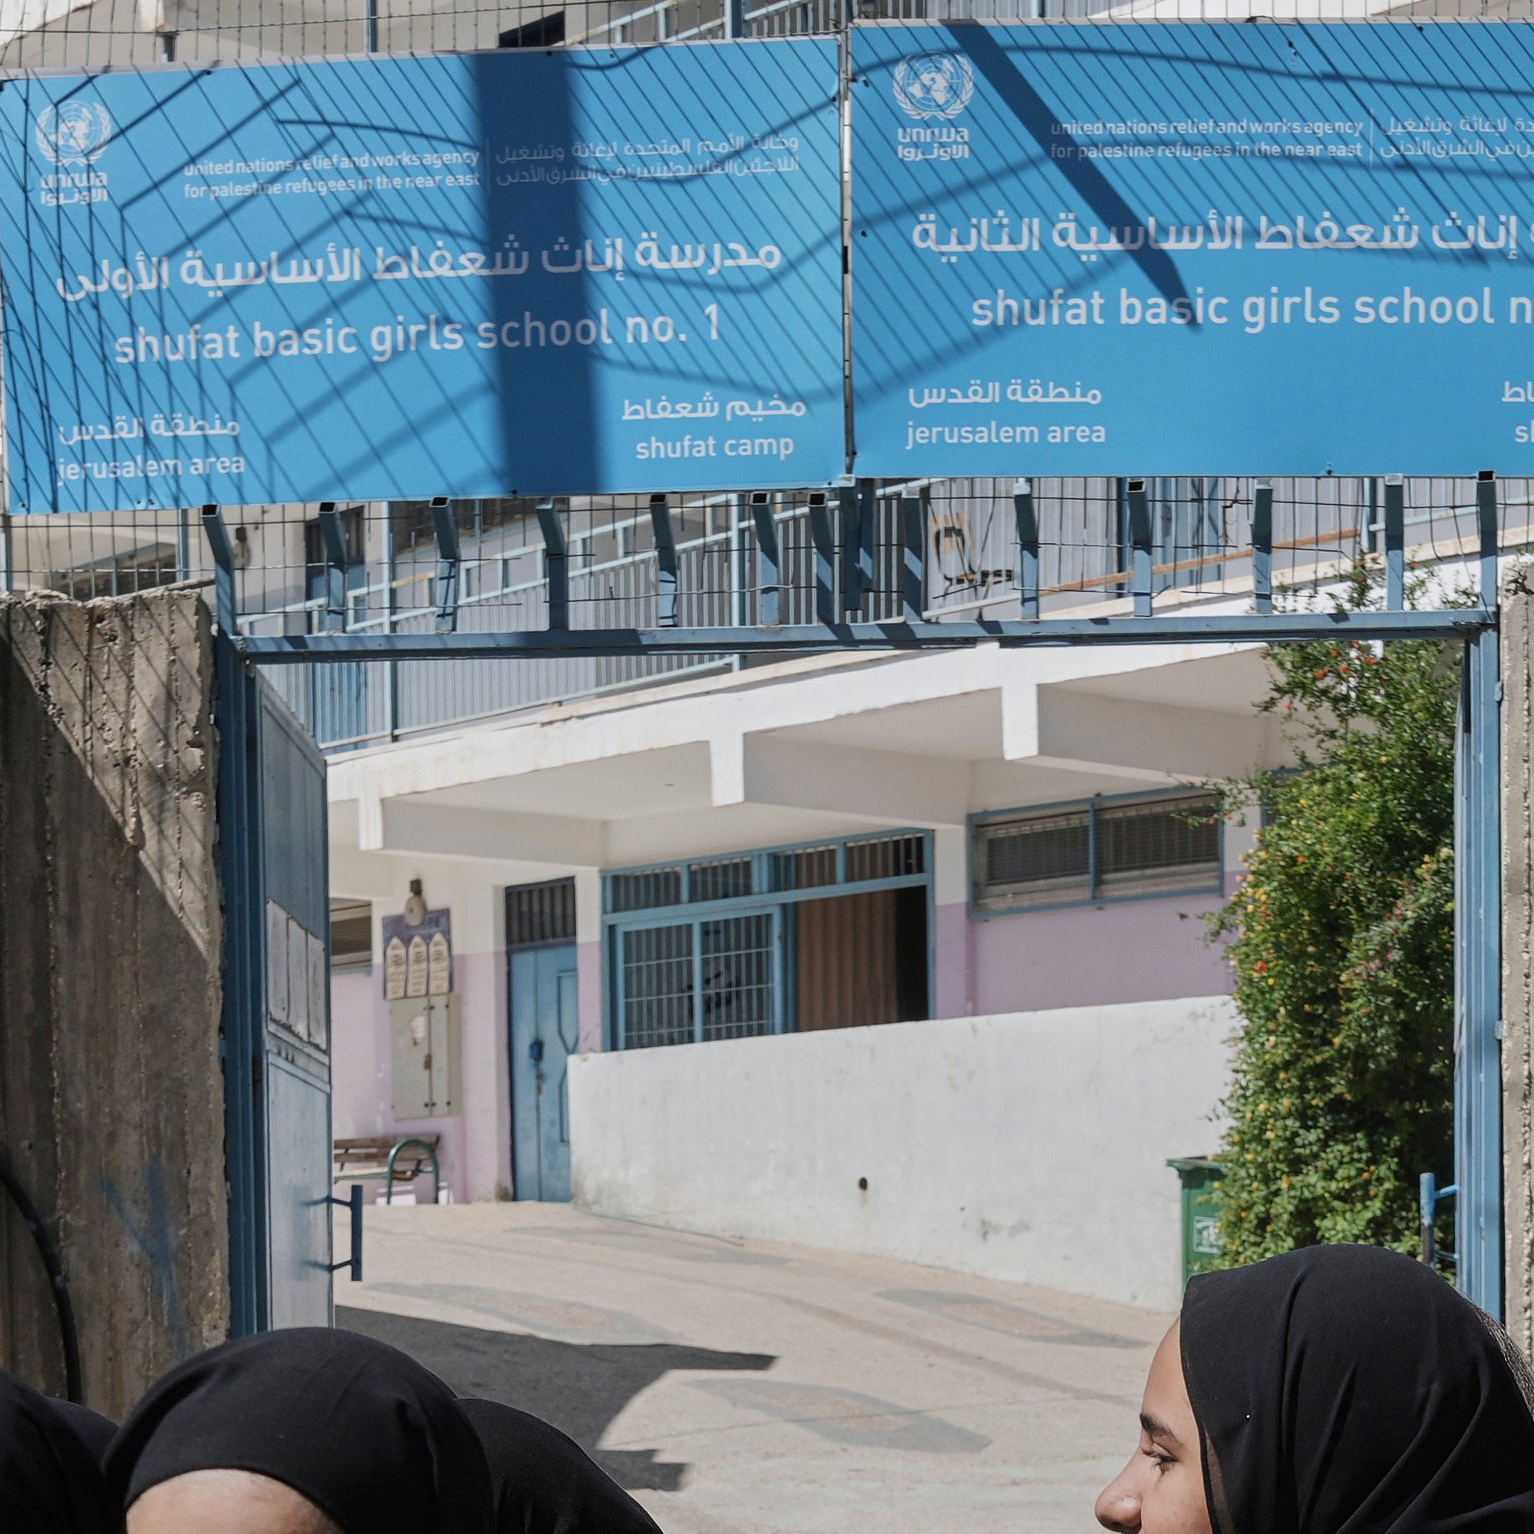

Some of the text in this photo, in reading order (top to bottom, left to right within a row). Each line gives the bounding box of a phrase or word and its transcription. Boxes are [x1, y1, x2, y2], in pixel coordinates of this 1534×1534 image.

[897, 127, 969, 142] unrwa
[1051, 118, 1363, 138] united nations relief and works agency
[184, 151, 480, 176] united nations relief and works agency
[1051, 142, 1363, 161] for palestine refugees in the near east
[41, 171, 108, 189] unrwa
[184, 172, 481, 201] for palestine refugees in the near east
[912, 210, 1040, 263] الثانية
[1051, 210, 1243, 262] الأساسية
[1255, 207, 1419, 250] شعفاط
[1432, 211, 1518, 260] إناث
[56, 231, 782, 302] مدرسة إناث شعفاط الأساسية الأولى
[971, 288, 1105, 326] shufat
[1119, 287, 1228, 325] basic
[1243, 287, 1340, 334] girls
[1354, 287, 1495, 324] school
[115, 304, 719, 364] shufat basic girls school no. 1
[622, 391, 806, 422] مخيم شعفاط
[908, 378, 1102, 408] منطقة القدس
[58, 413, 241, 446] منطقة القدس
[906, 421, 1105, 450] jerusalem area
[635, 435, 794, 460] shufat camp
[57, 454, 245, 487] jerusalem area
